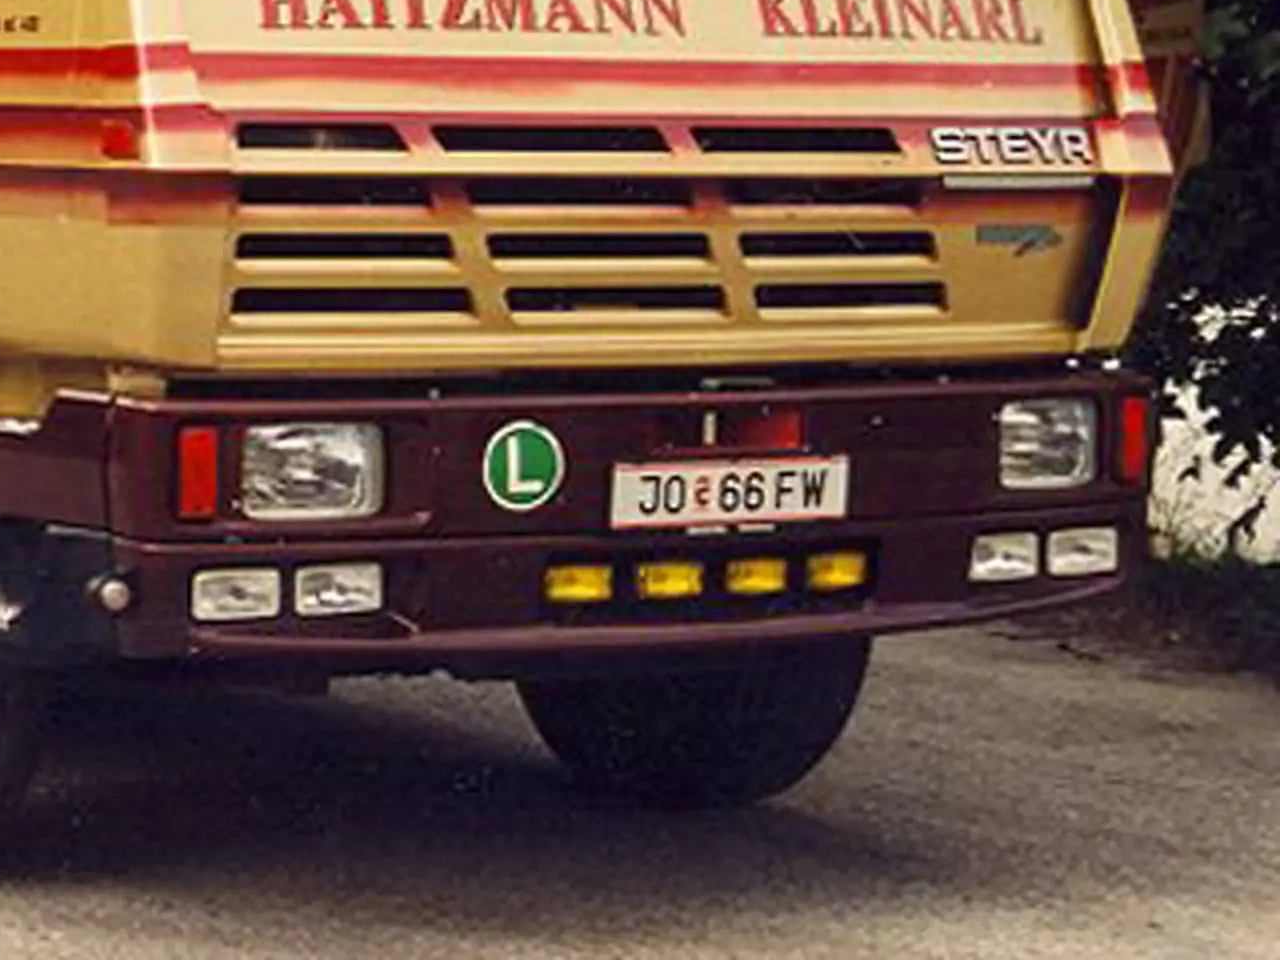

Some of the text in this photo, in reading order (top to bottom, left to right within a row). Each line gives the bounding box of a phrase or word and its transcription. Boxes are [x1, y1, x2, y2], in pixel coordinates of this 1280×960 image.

[930, 126, 1093, 165] STEYR
[507, 435, 546, 493] L
[638, 474, 687, 516] JO
